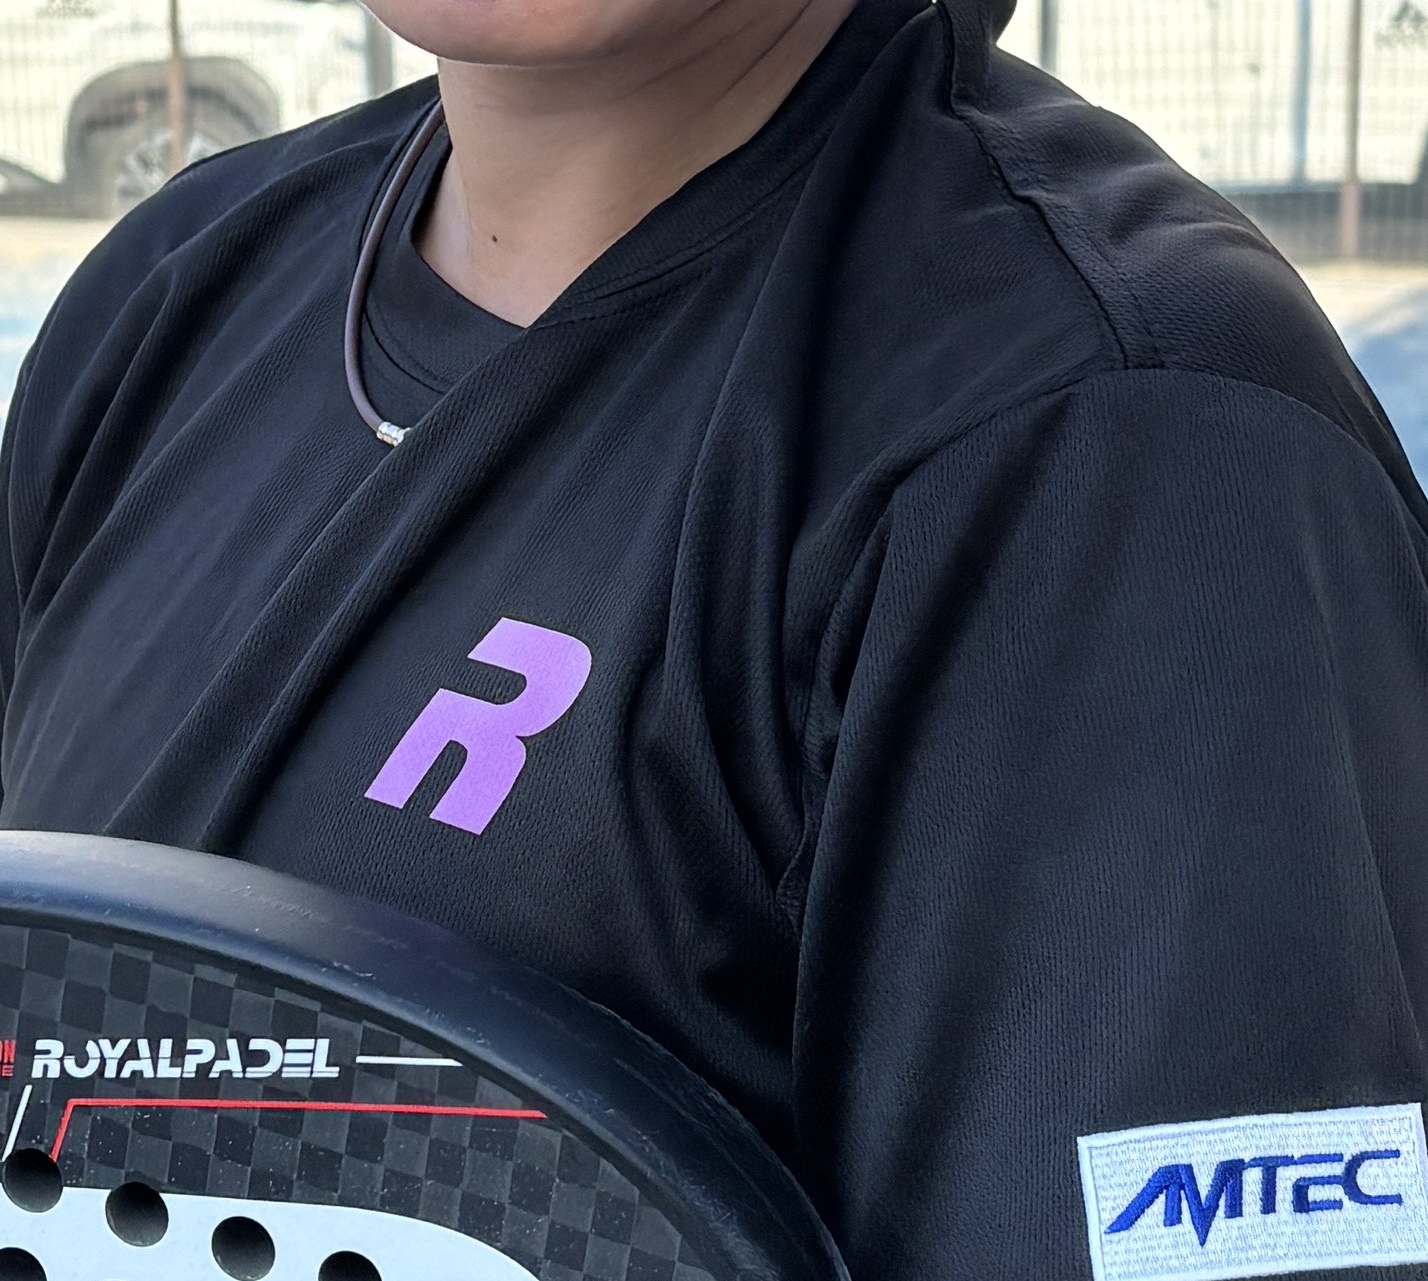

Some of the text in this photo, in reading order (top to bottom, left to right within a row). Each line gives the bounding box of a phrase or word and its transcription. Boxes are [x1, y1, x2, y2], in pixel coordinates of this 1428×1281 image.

[364, 617, 592, 835] R
[31, 1038, 340, 1079] ROYALPADEL
[1104, 1149, 1402, 1247] AMTEC
